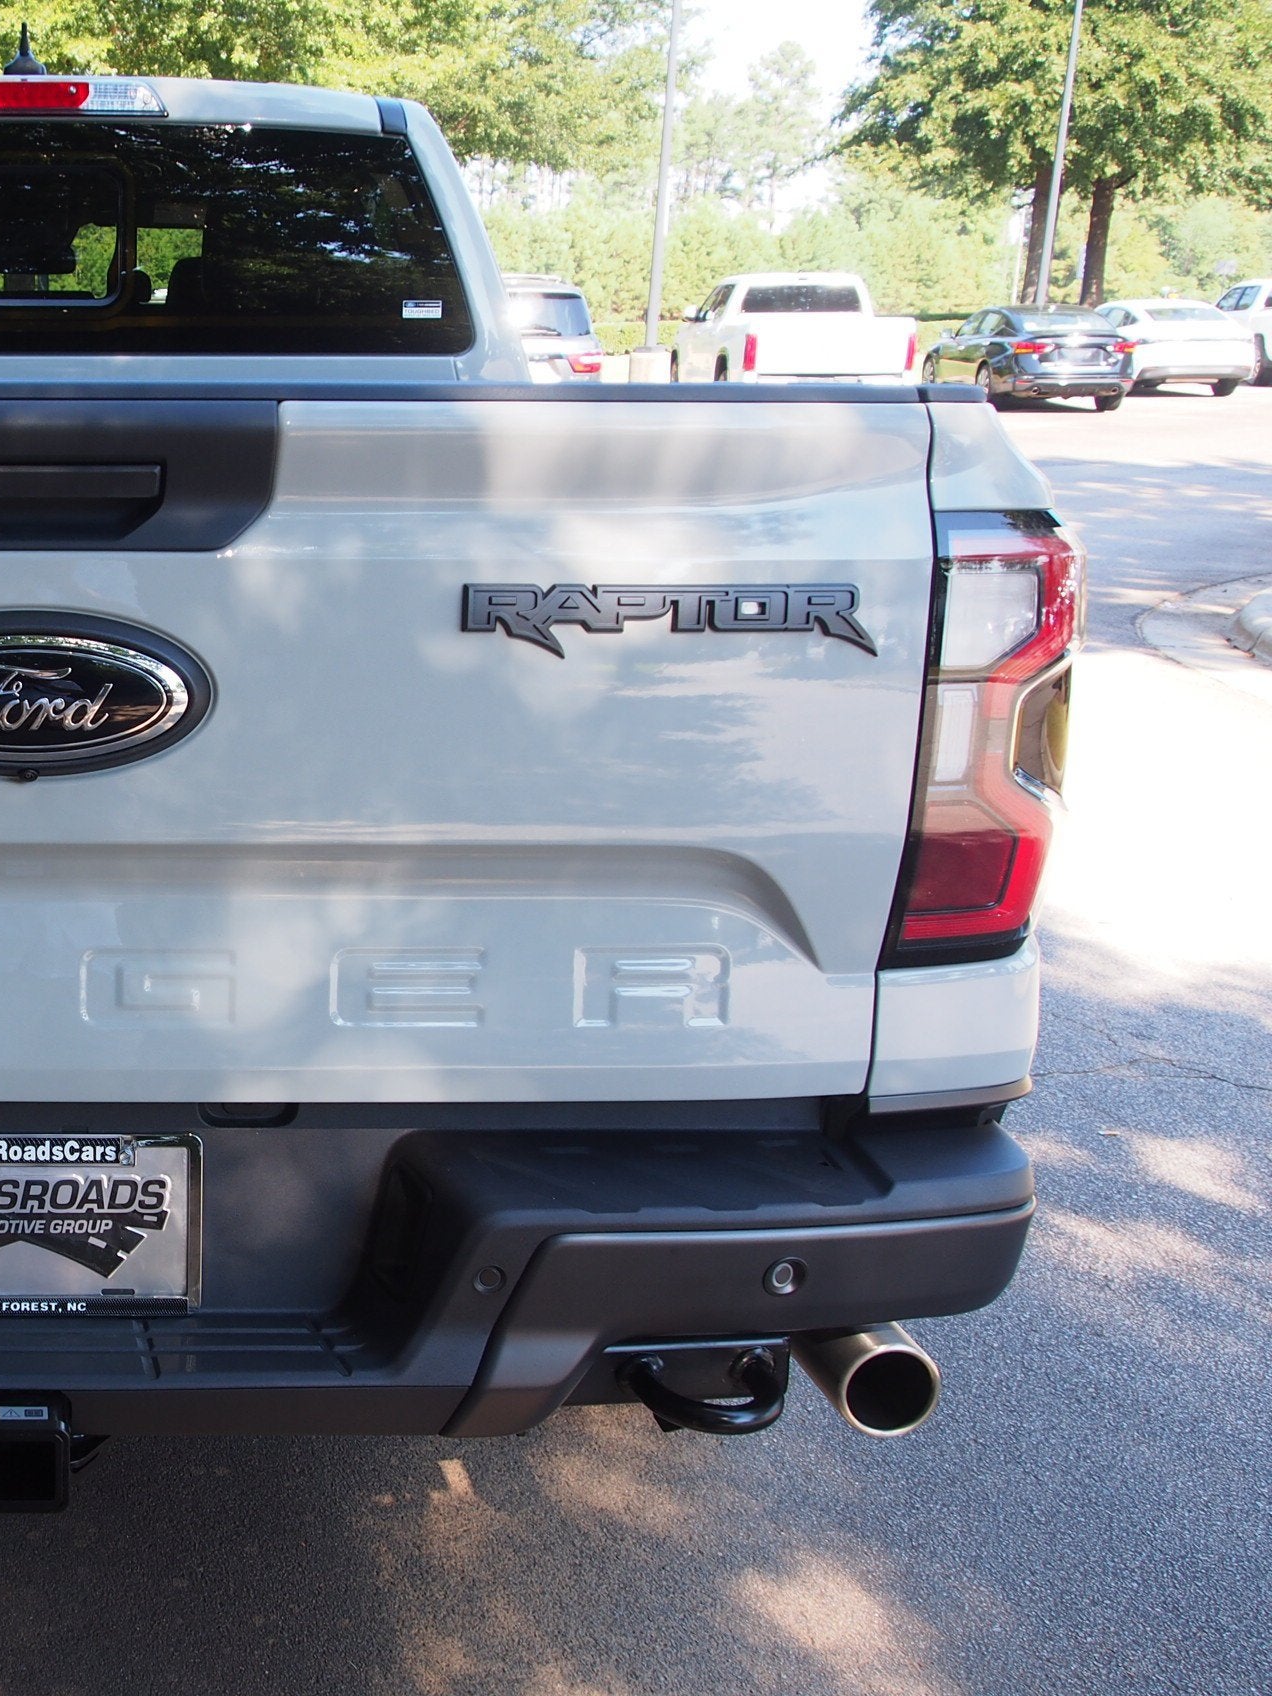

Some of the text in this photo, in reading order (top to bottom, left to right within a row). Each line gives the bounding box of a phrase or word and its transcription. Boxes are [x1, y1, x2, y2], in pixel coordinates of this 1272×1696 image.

[461, 584, 878, 659] RAPTOR
[49, 1219, 113, 1235] GROUP
[1, 1301, 63, 1313] FOREST,
[66, 1301, 87, 1312] NC
